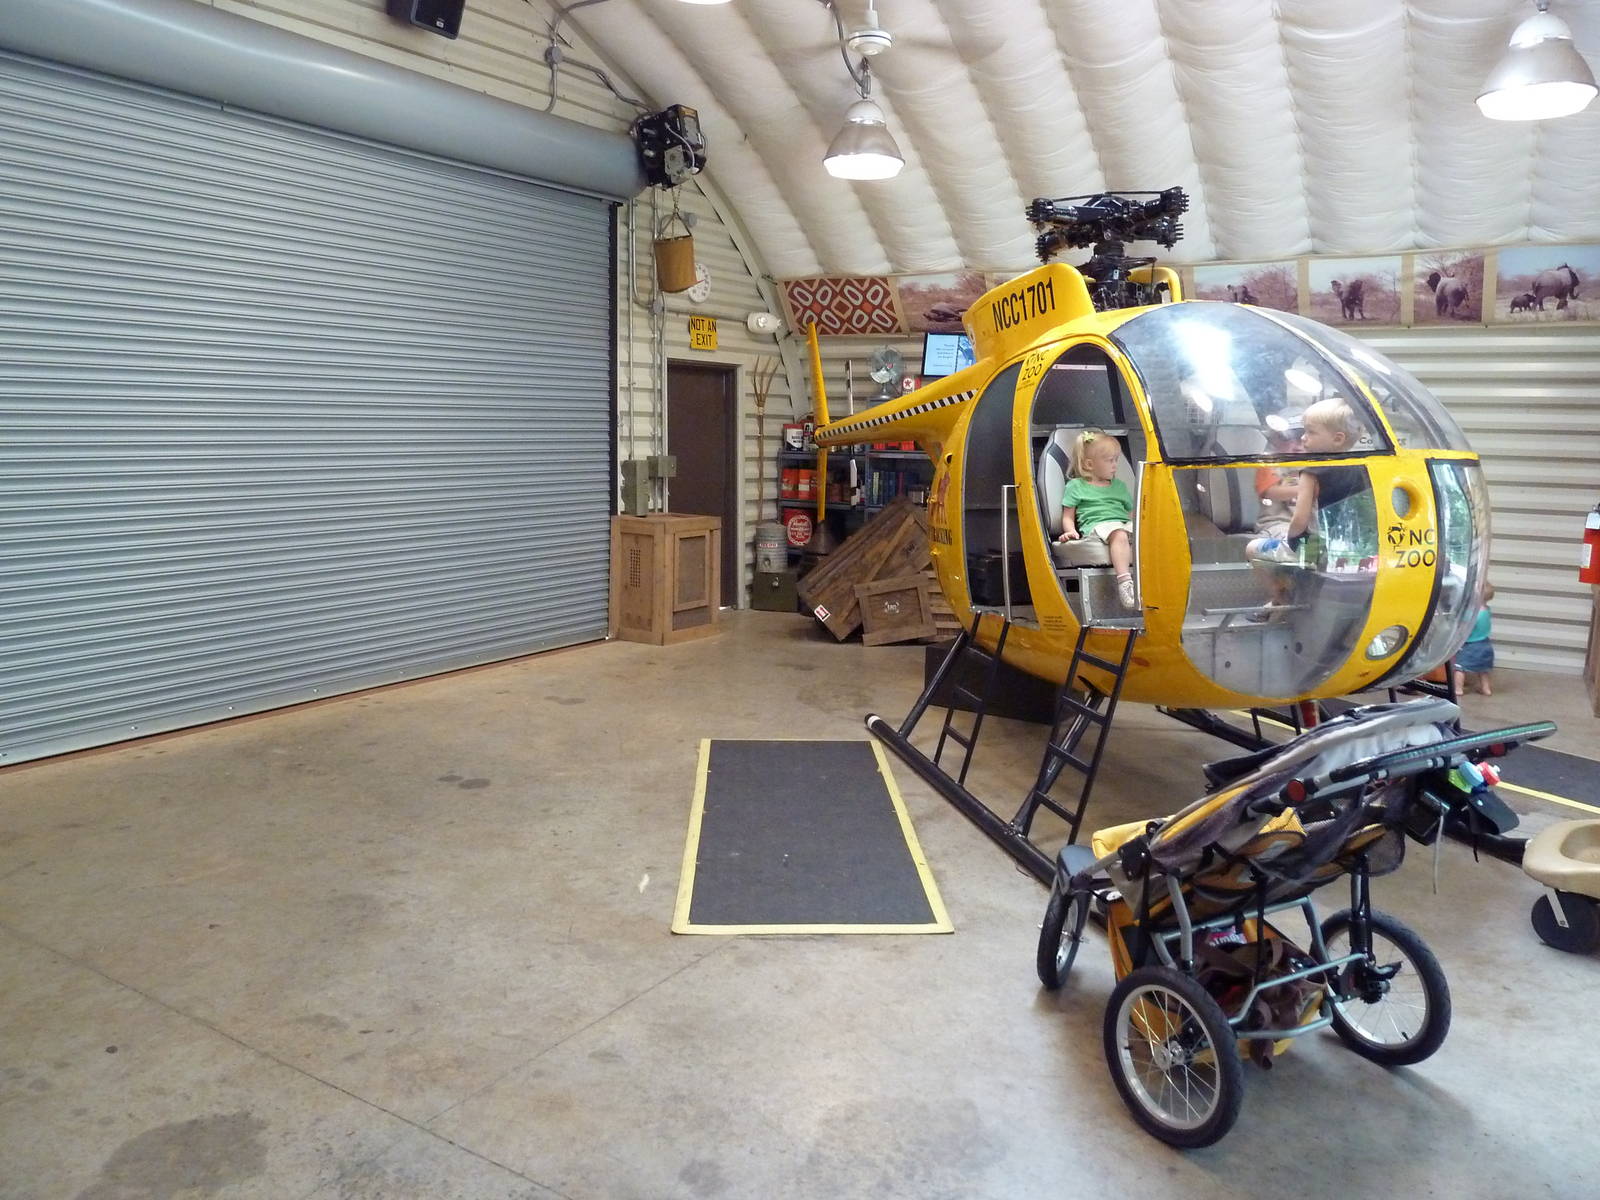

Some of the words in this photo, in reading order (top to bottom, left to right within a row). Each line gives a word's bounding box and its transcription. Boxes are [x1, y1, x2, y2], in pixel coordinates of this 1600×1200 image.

[992, 276, 1056, 333] NCC1701
[690, 317, 705, 331] NOT
[707, 319, 717, 333] AN
[696, 333, 712, 347] EXIT
[1022, 363, 1042, 380] ZOO
[1409, 528, 1435, 546] NC
[1395, 549, 1436, 568] ZOO
